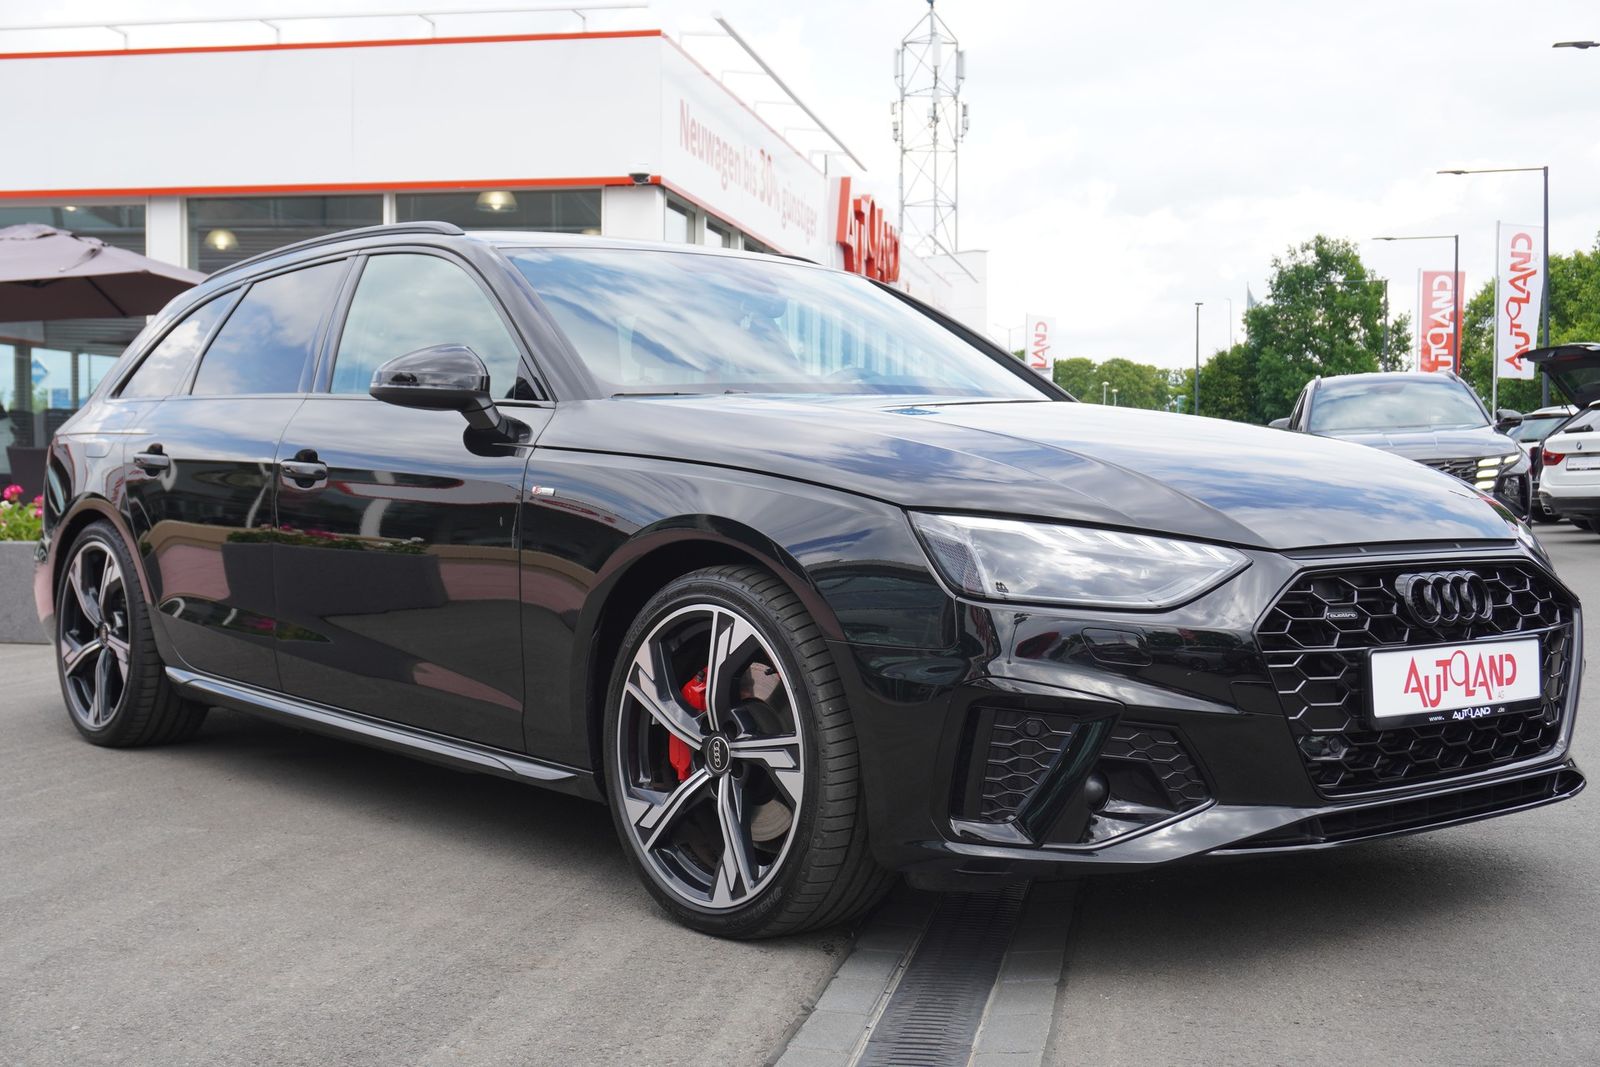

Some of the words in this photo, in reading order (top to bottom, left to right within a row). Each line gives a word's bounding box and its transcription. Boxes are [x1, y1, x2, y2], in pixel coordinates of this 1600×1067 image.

[680, 99, 741, 191] Neuwagen
[1505, 232, 1537, 371] AUTOLAND
[1403, 650, 1517, 708] AUTOLAND
[1452, 706, 1491, 720] AUTOLAND
